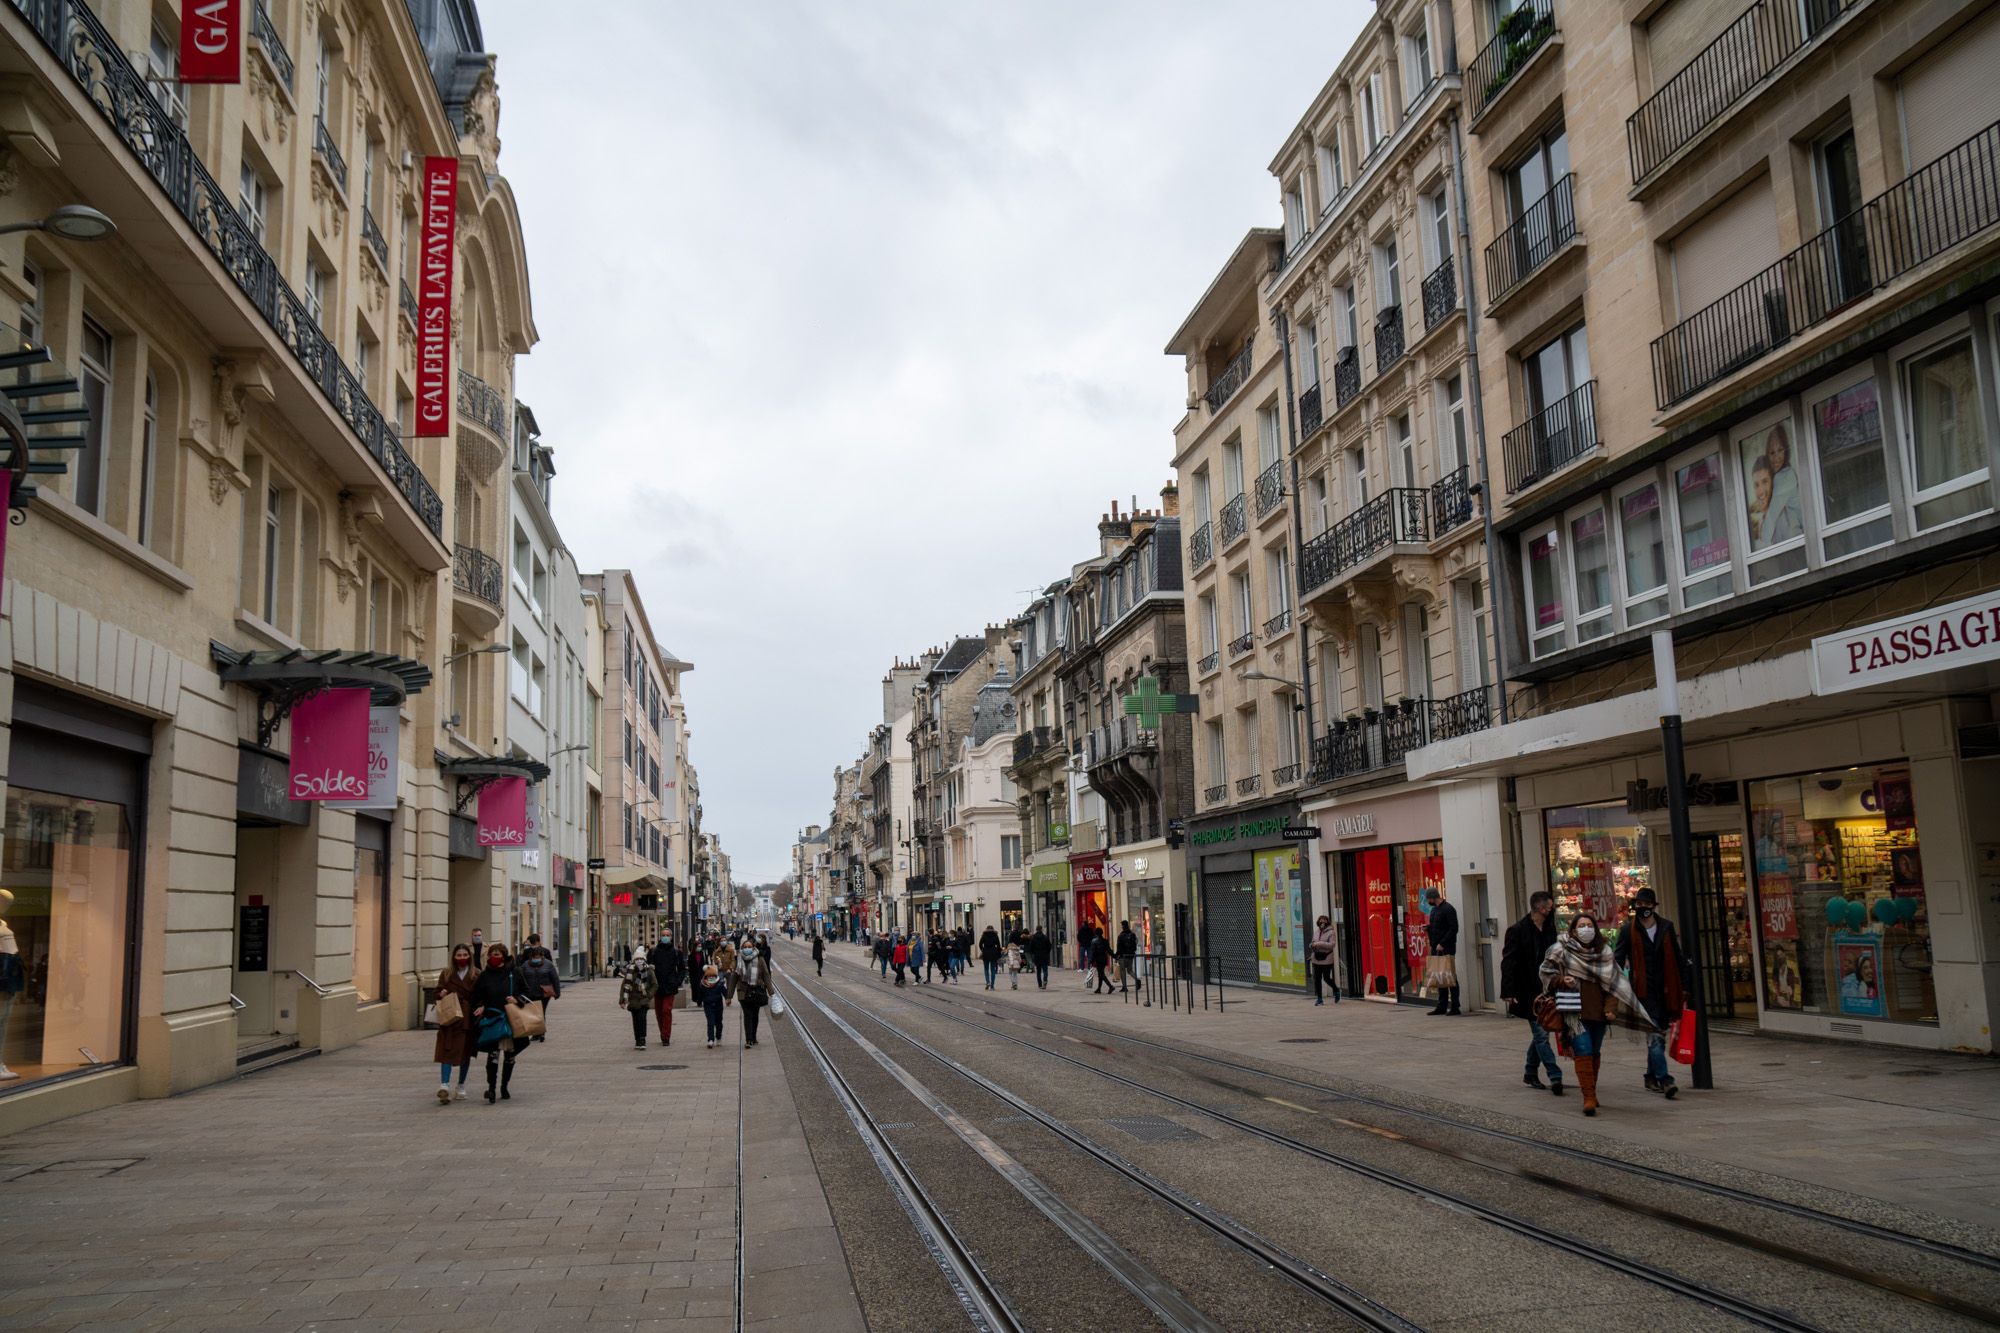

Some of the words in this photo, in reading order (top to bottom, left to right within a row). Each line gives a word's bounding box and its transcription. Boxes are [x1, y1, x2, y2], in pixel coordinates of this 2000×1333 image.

[426, 171, 451, 299] LAFAYETTE
[422, 306, 445, 422] GALERIES
[293, 768, 367, 797] Soldes
[479, 824, 524, 843] Soldes
[1193, 827, 1234, 846] PHARMACIE
[1762, 896, 1793, 912] JUSQU'À
[1766, 913, 1792, 932] -50%
